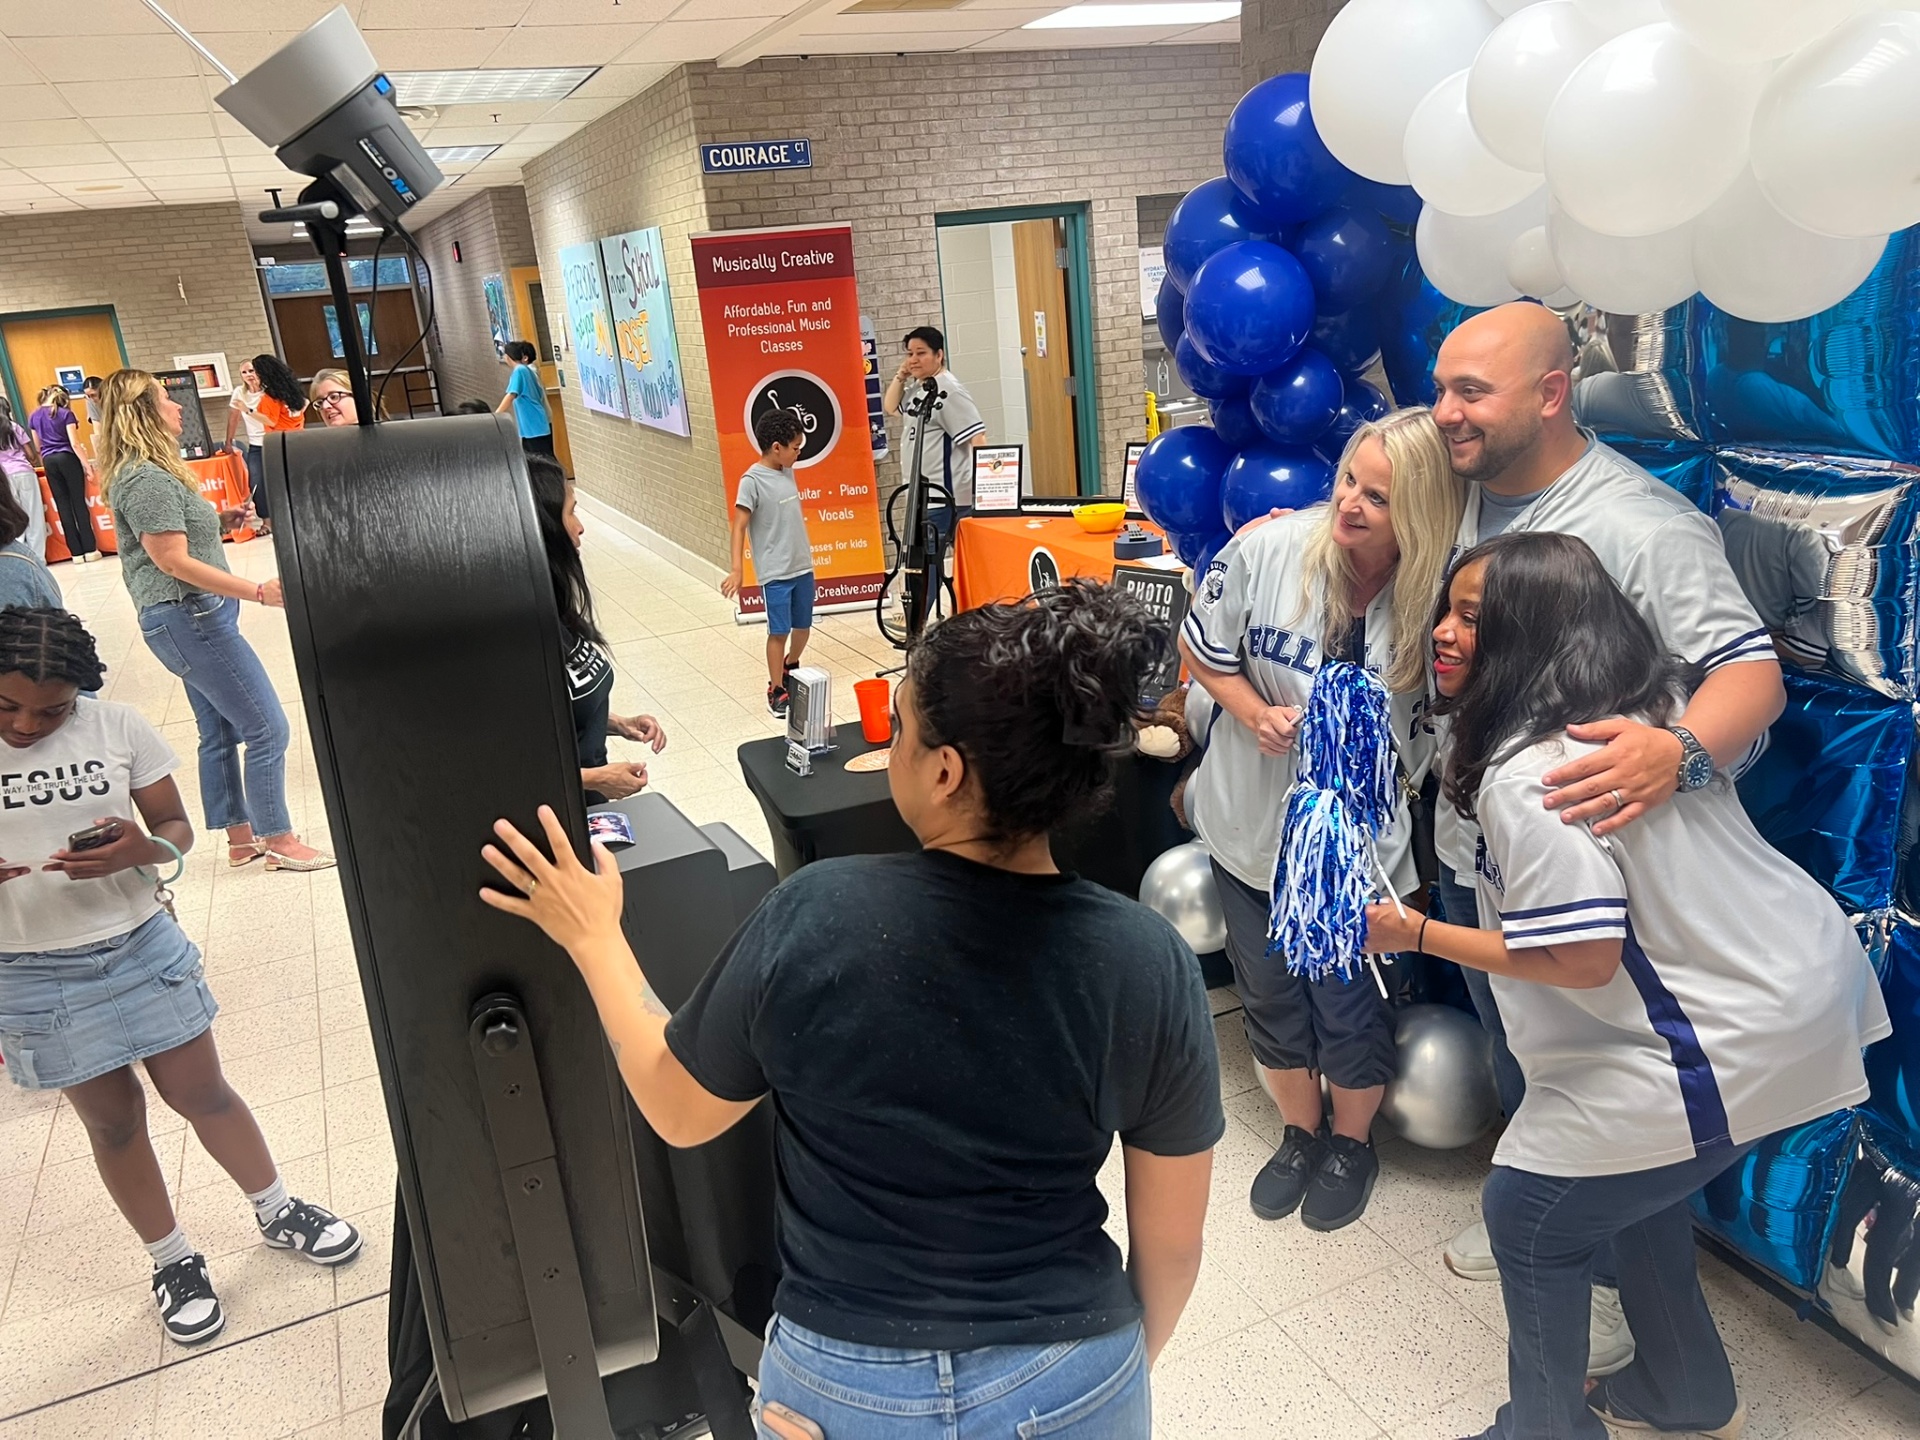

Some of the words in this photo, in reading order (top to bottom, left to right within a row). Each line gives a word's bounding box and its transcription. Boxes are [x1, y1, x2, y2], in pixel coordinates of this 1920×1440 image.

[709, 145, 791, 168] COURAGE
[794, 142, 805, 153] CT
[382, 167, 417, 203] ONE
[712, 253, 777, 273] Musically
[781, 249, 835, 268] Creative
[723, 302, 785, 319] Affordable,
[787, 299, 807, 313] Fun
[811, 297, 832, 312] and
[727, 319, 796, 338] Professional
[799, 317, 831, 331] Music
[760, 340, 803, 354] Classes
[798, 487, 822, 501] uitar
[840, 483, 869, 497] Piano
[818, 508, 854, 522] Vocals
[810, 543, 833, 553] asses
[835, 540, 847, 550] for
[850, 537, 868, 549] kids
[812, 555, 832, 566] ults!
[1127, 579, 1173, 605] PHOTO
[1144, 604, 1170, 620] OTH
[1, 760, 110, 810] ESUS
[3, 786, 25, 795] WAY.
[27, 784, 43, 792] THE
[44, 779, 72, 790] TRUTH.
[73, 776, 89, 785] THE
[90, 773, 106, 782] LIFE
